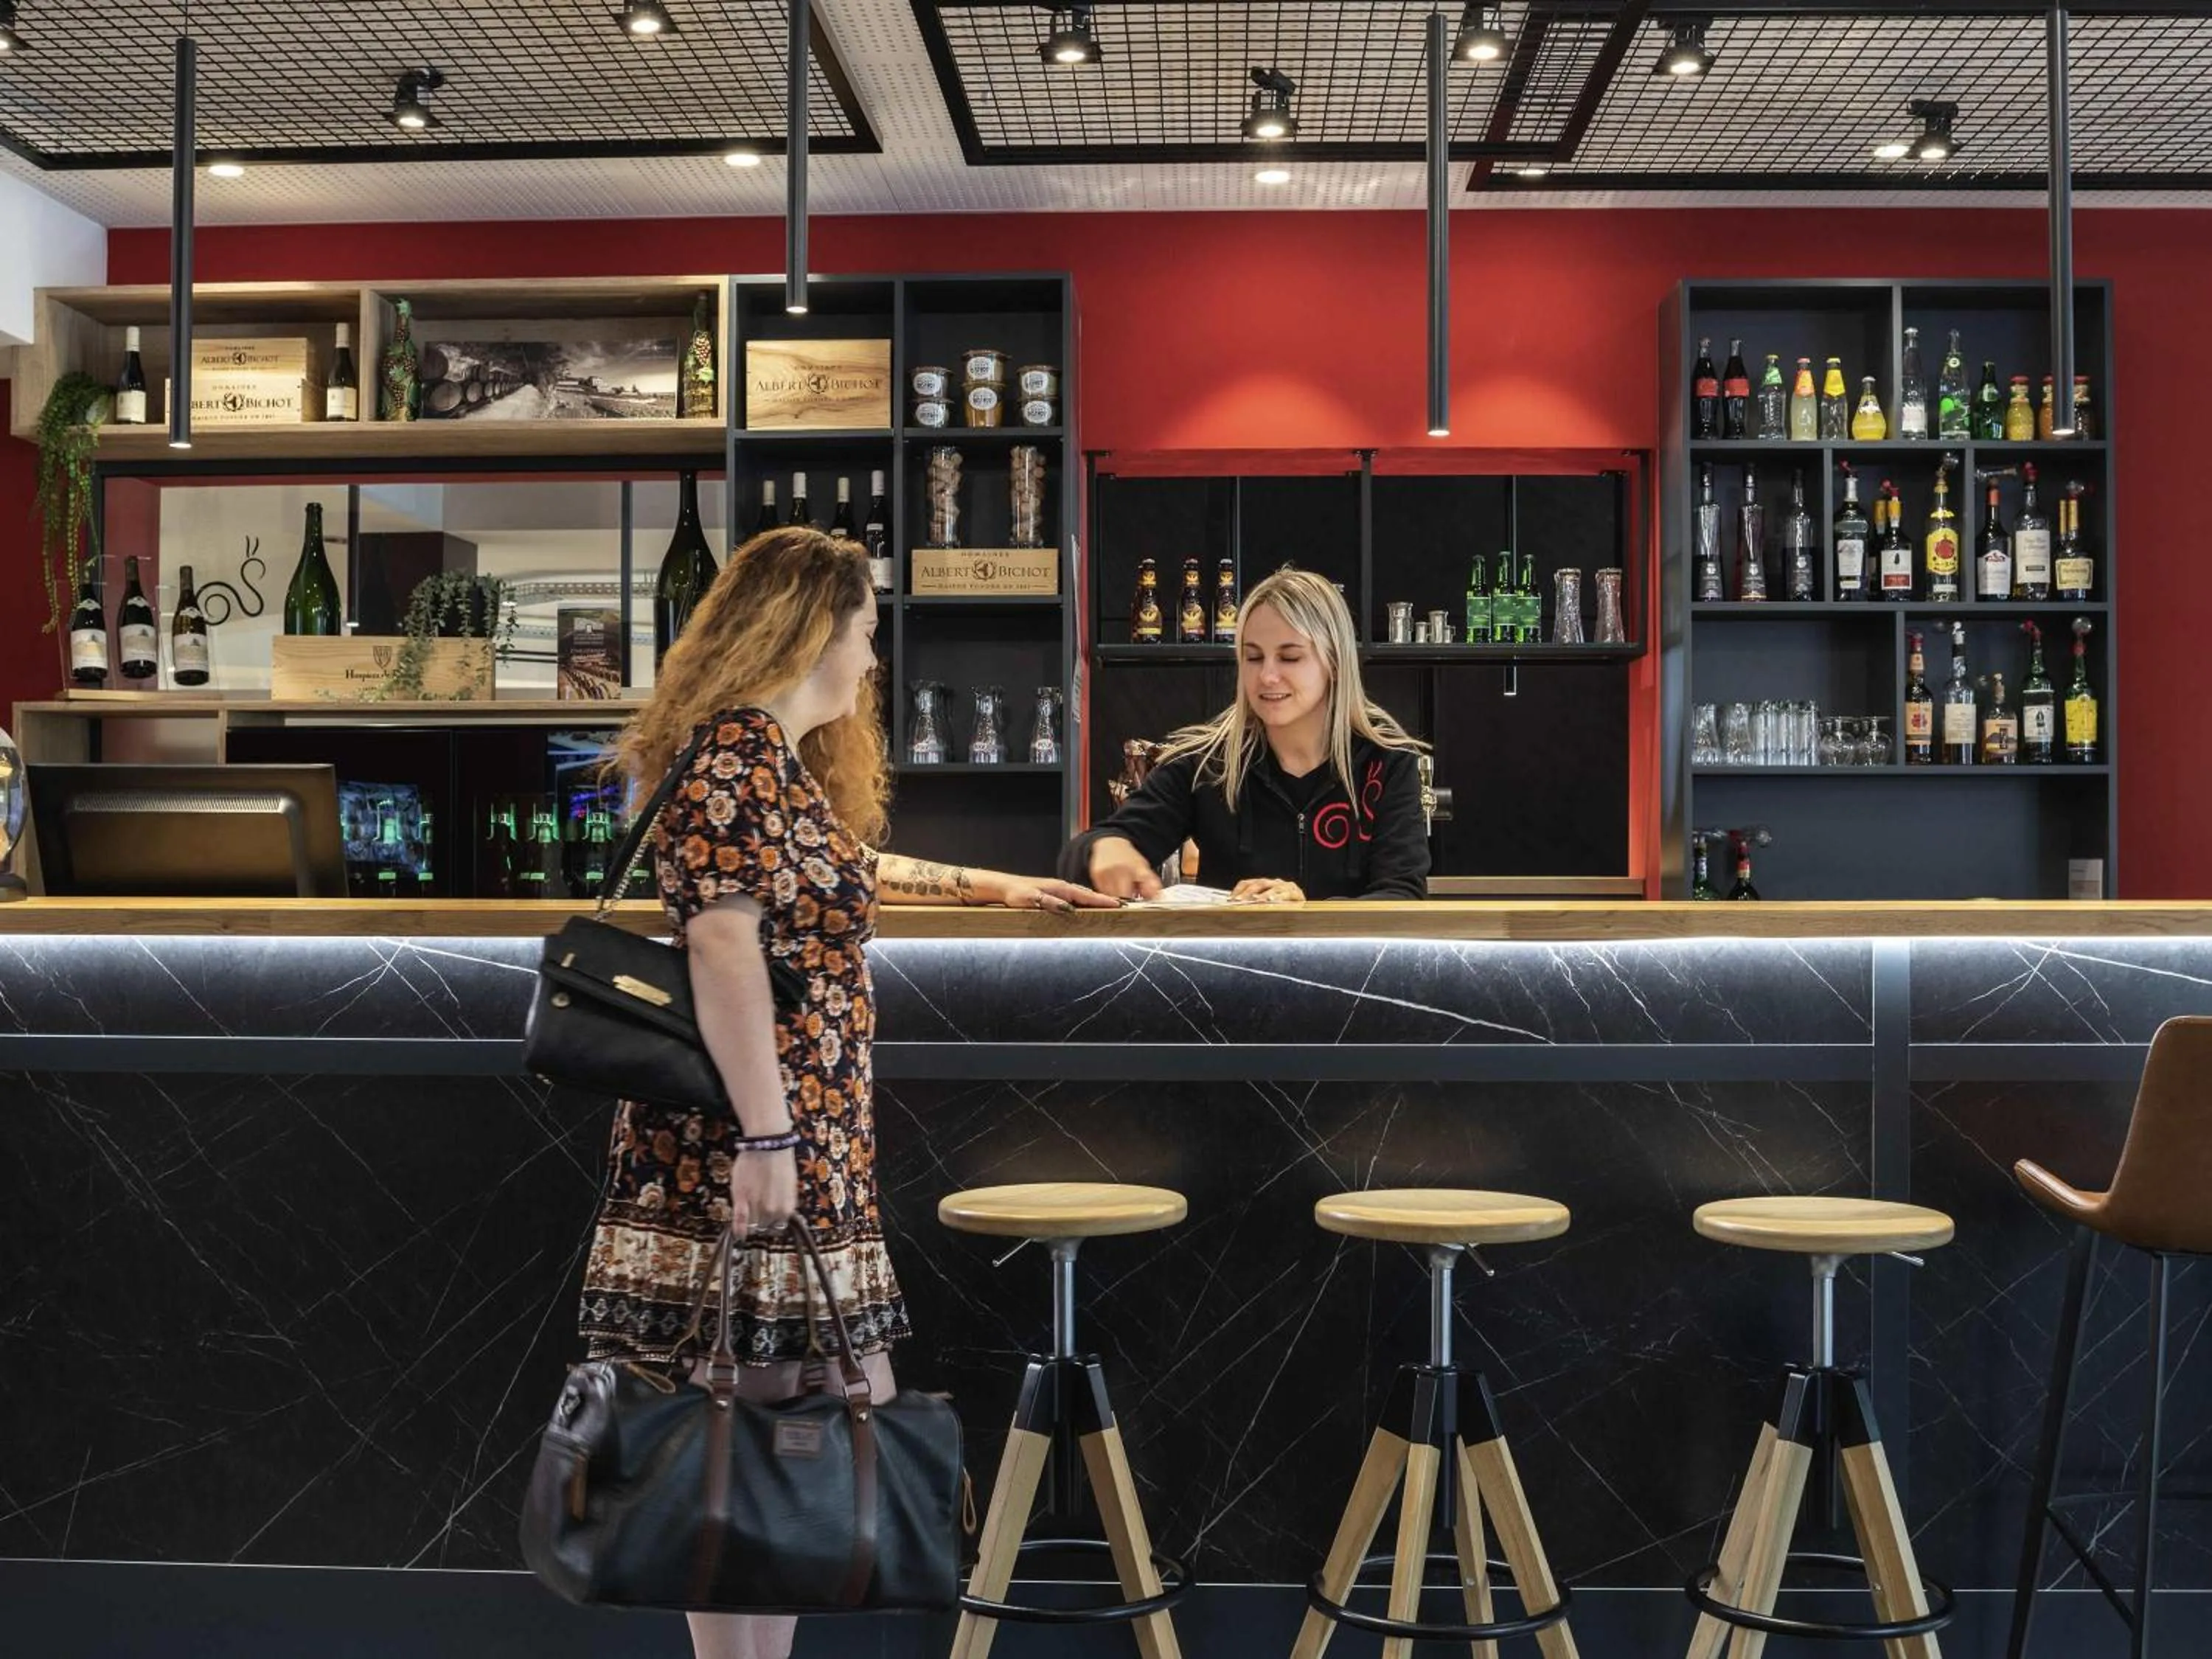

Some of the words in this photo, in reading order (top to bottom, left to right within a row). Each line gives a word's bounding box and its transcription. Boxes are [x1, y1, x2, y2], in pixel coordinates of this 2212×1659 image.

[756, 380, 801, 391] ALBERT
[831, 378, 882, 389] BICHOT
[190, 400, 220, 409] BERT
[246, 397, 293, 408] BICHOT
[922, 566, 972, 577] ALBERT
[998, 566, 1050, 577] BICHOT
